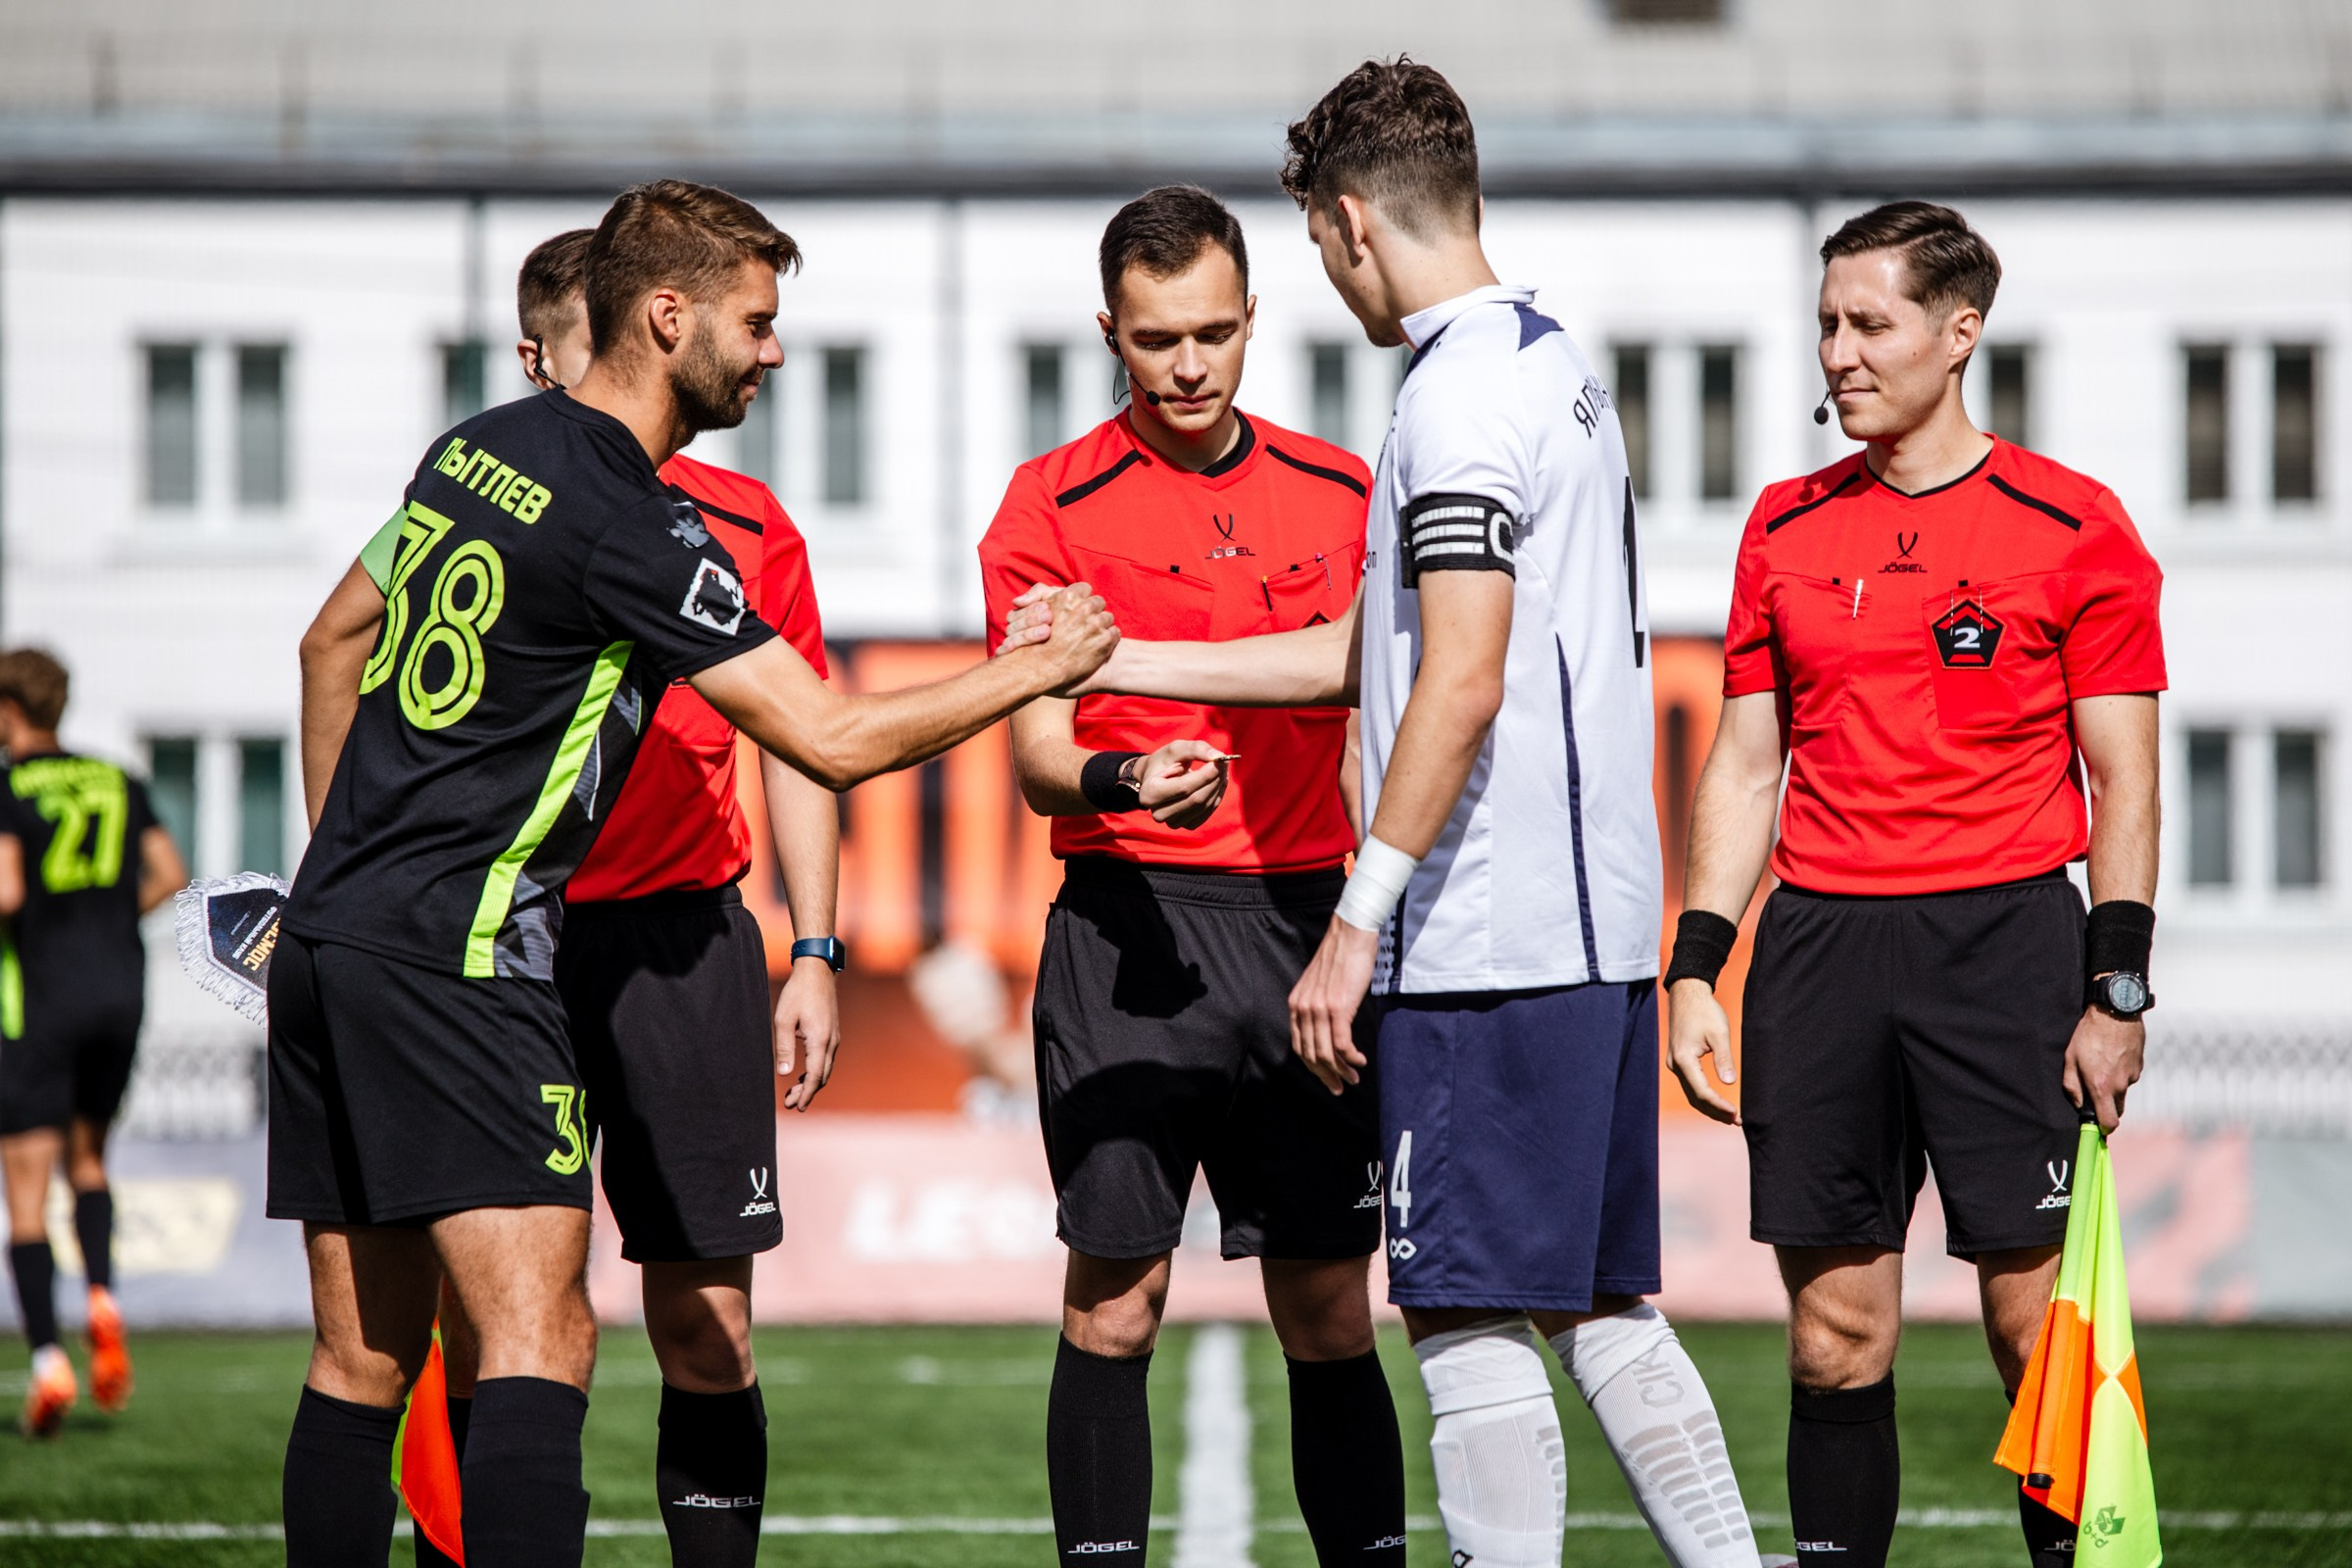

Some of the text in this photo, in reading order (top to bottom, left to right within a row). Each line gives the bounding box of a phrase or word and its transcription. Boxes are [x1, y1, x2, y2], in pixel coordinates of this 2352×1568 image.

[432, 437, 553, 525] ПЫТЛЕВ
[1204, 545, 1256, 560] JÖGEL
[1878, 562, 1928, 573] JÖGEL
[359, 500, 505, 730] 38
[1954, 627, 1981, 649] 2
[36, 785, 128, 895] 27
[540, 1084, 592, 1175] 3
[1390, 1130, 1412, 1228] 4
[739, 1201, 776, 1217] JÖGEL
[1353, 1195, 1382, 1208] JÖGE
[2035, 1195, 2072, 1209] JÖGE
[672, 1494, 761, 1508] JÖGEL
[1066, 1540, 1141, 1554] JÖGEL
[1363, 1535, 1406, 1549] JÖG
[1793, 1538, 1847, 1551] GEL
